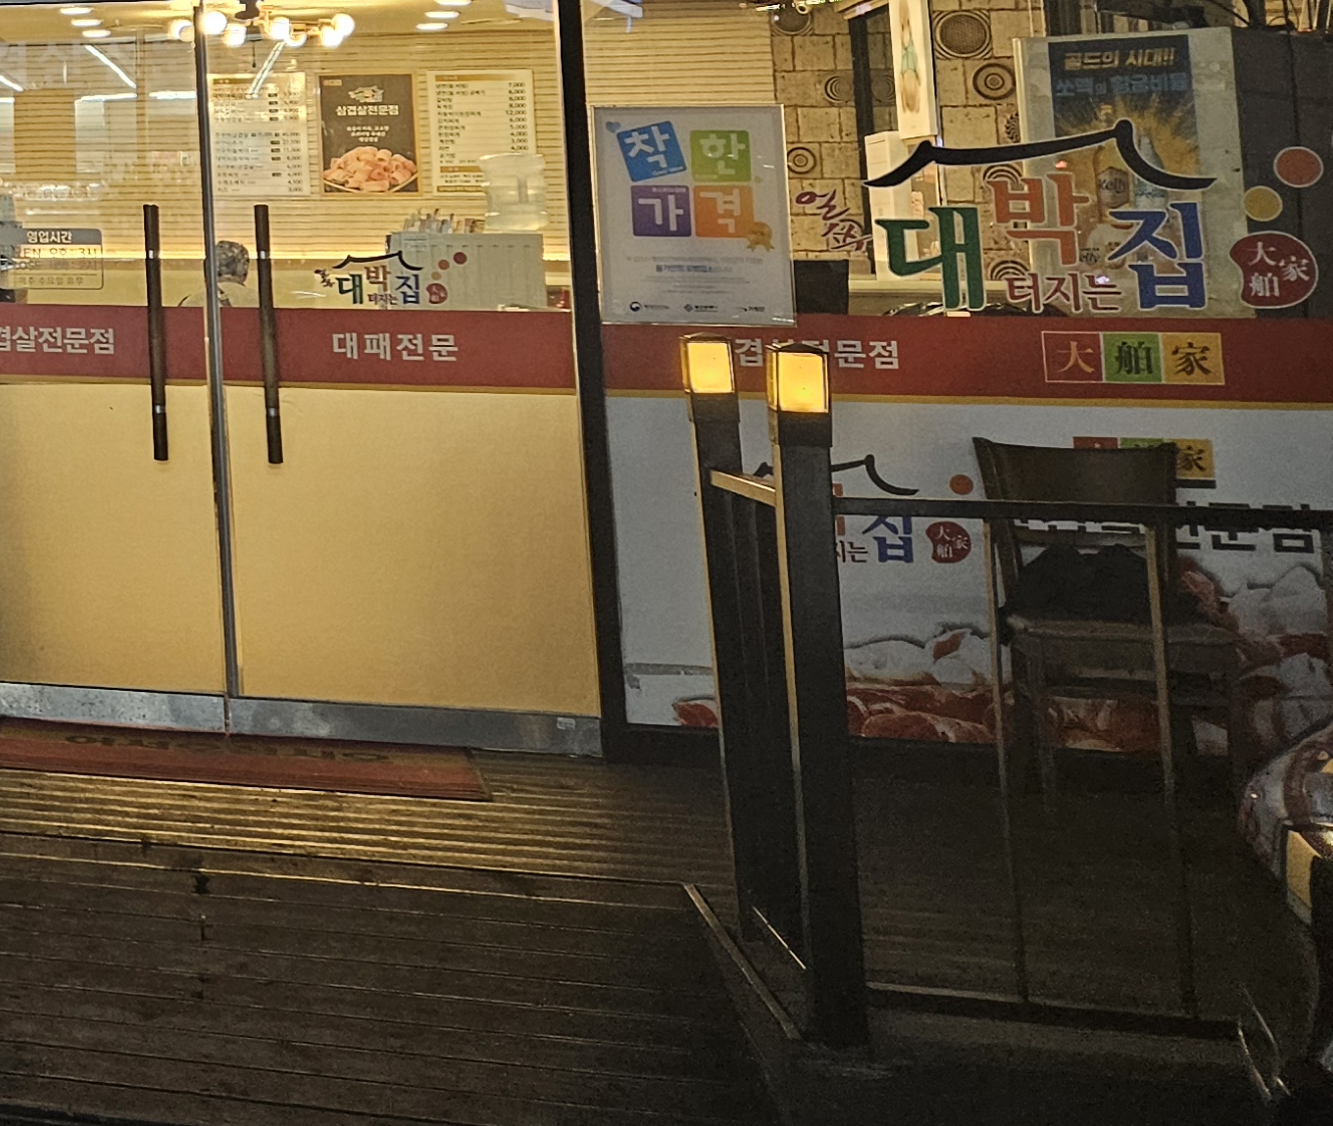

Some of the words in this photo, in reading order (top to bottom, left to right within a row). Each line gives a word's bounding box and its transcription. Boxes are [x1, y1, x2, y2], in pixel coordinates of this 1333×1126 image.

[335, 104, 399, 116] 삼겹살전문점
[624, 126, 746, 175] 착한
[637, 189, 741, 233] 가격
[27, 231, 73, 244] 영업시간
[1004, 273, 1123, 314] 터지는
[332, 333, 459, 361] 대패전문
